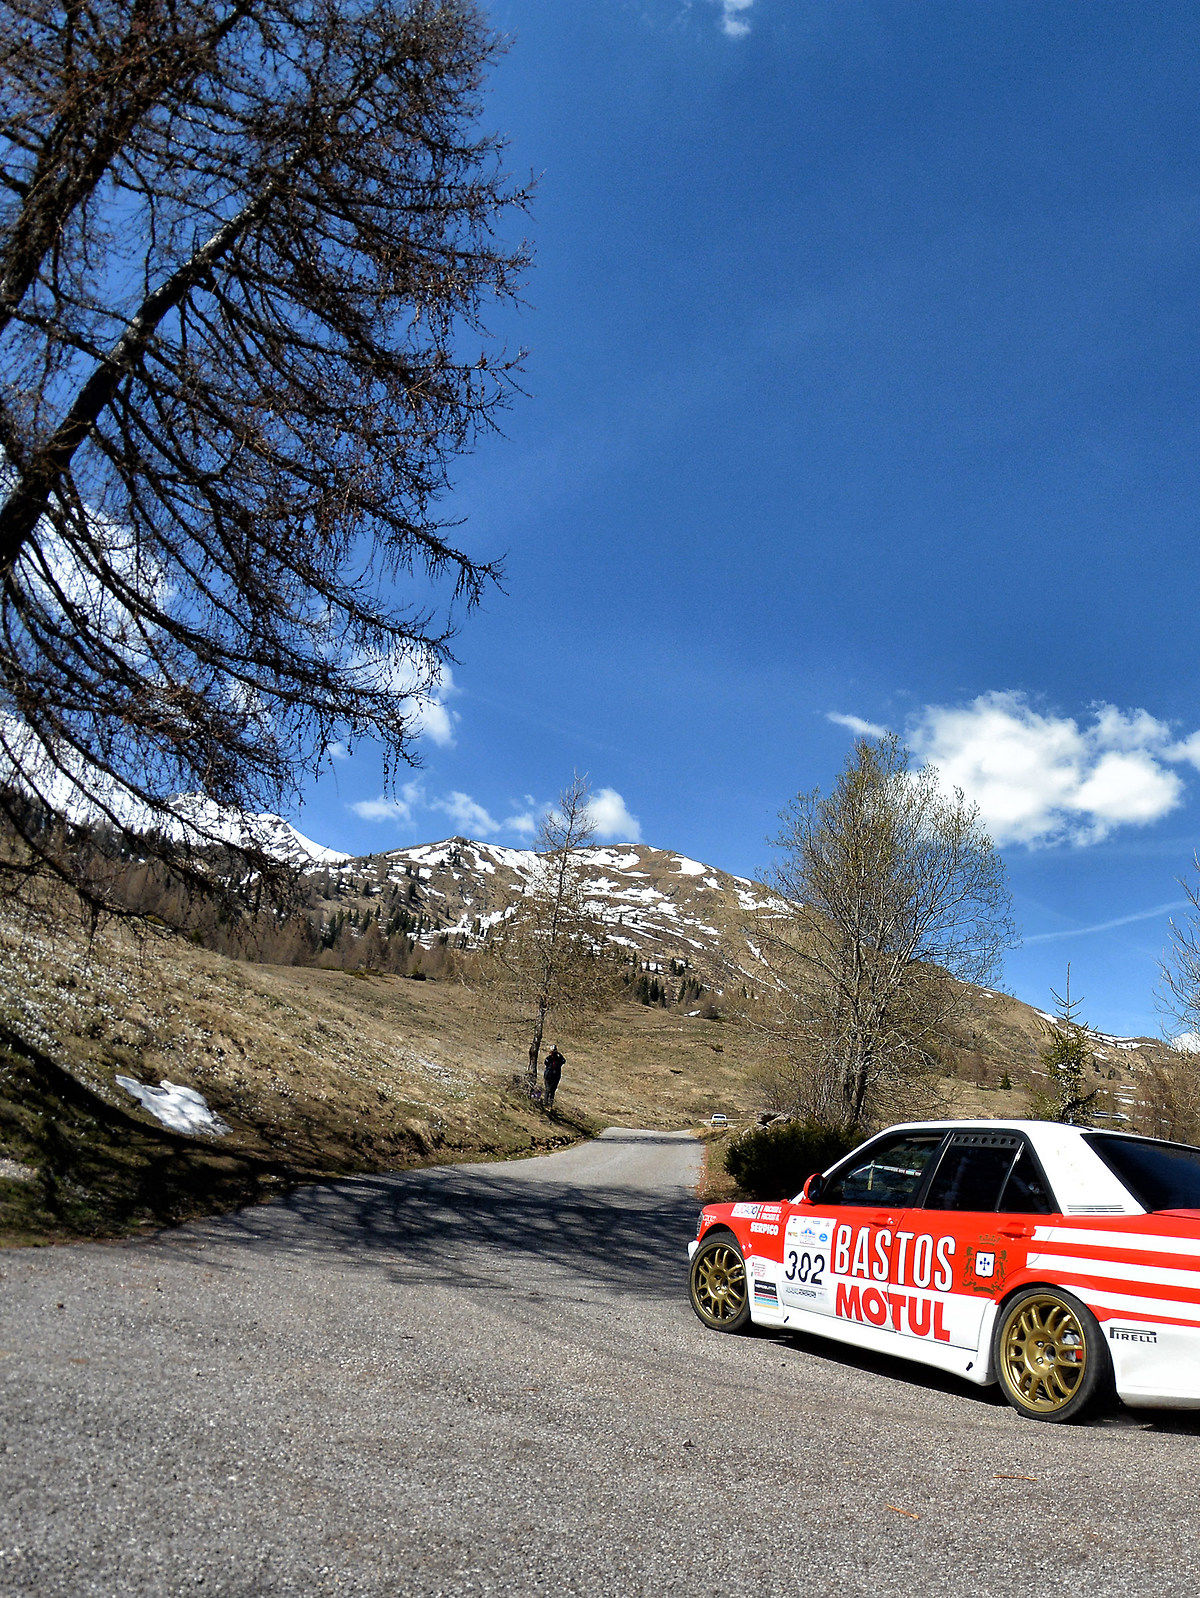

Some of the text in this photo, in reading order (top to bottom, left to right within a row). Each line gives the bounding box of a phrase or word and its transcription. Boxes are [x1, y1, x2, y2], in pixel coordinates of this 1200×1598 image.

[785, 1250, 825, 1285] 302
[834, 1223, 956, 1293] BASTOS
[835, 1282, 951, 1343] MOTUL
[1110, 1327, 1157, 1344] PIRELLI
